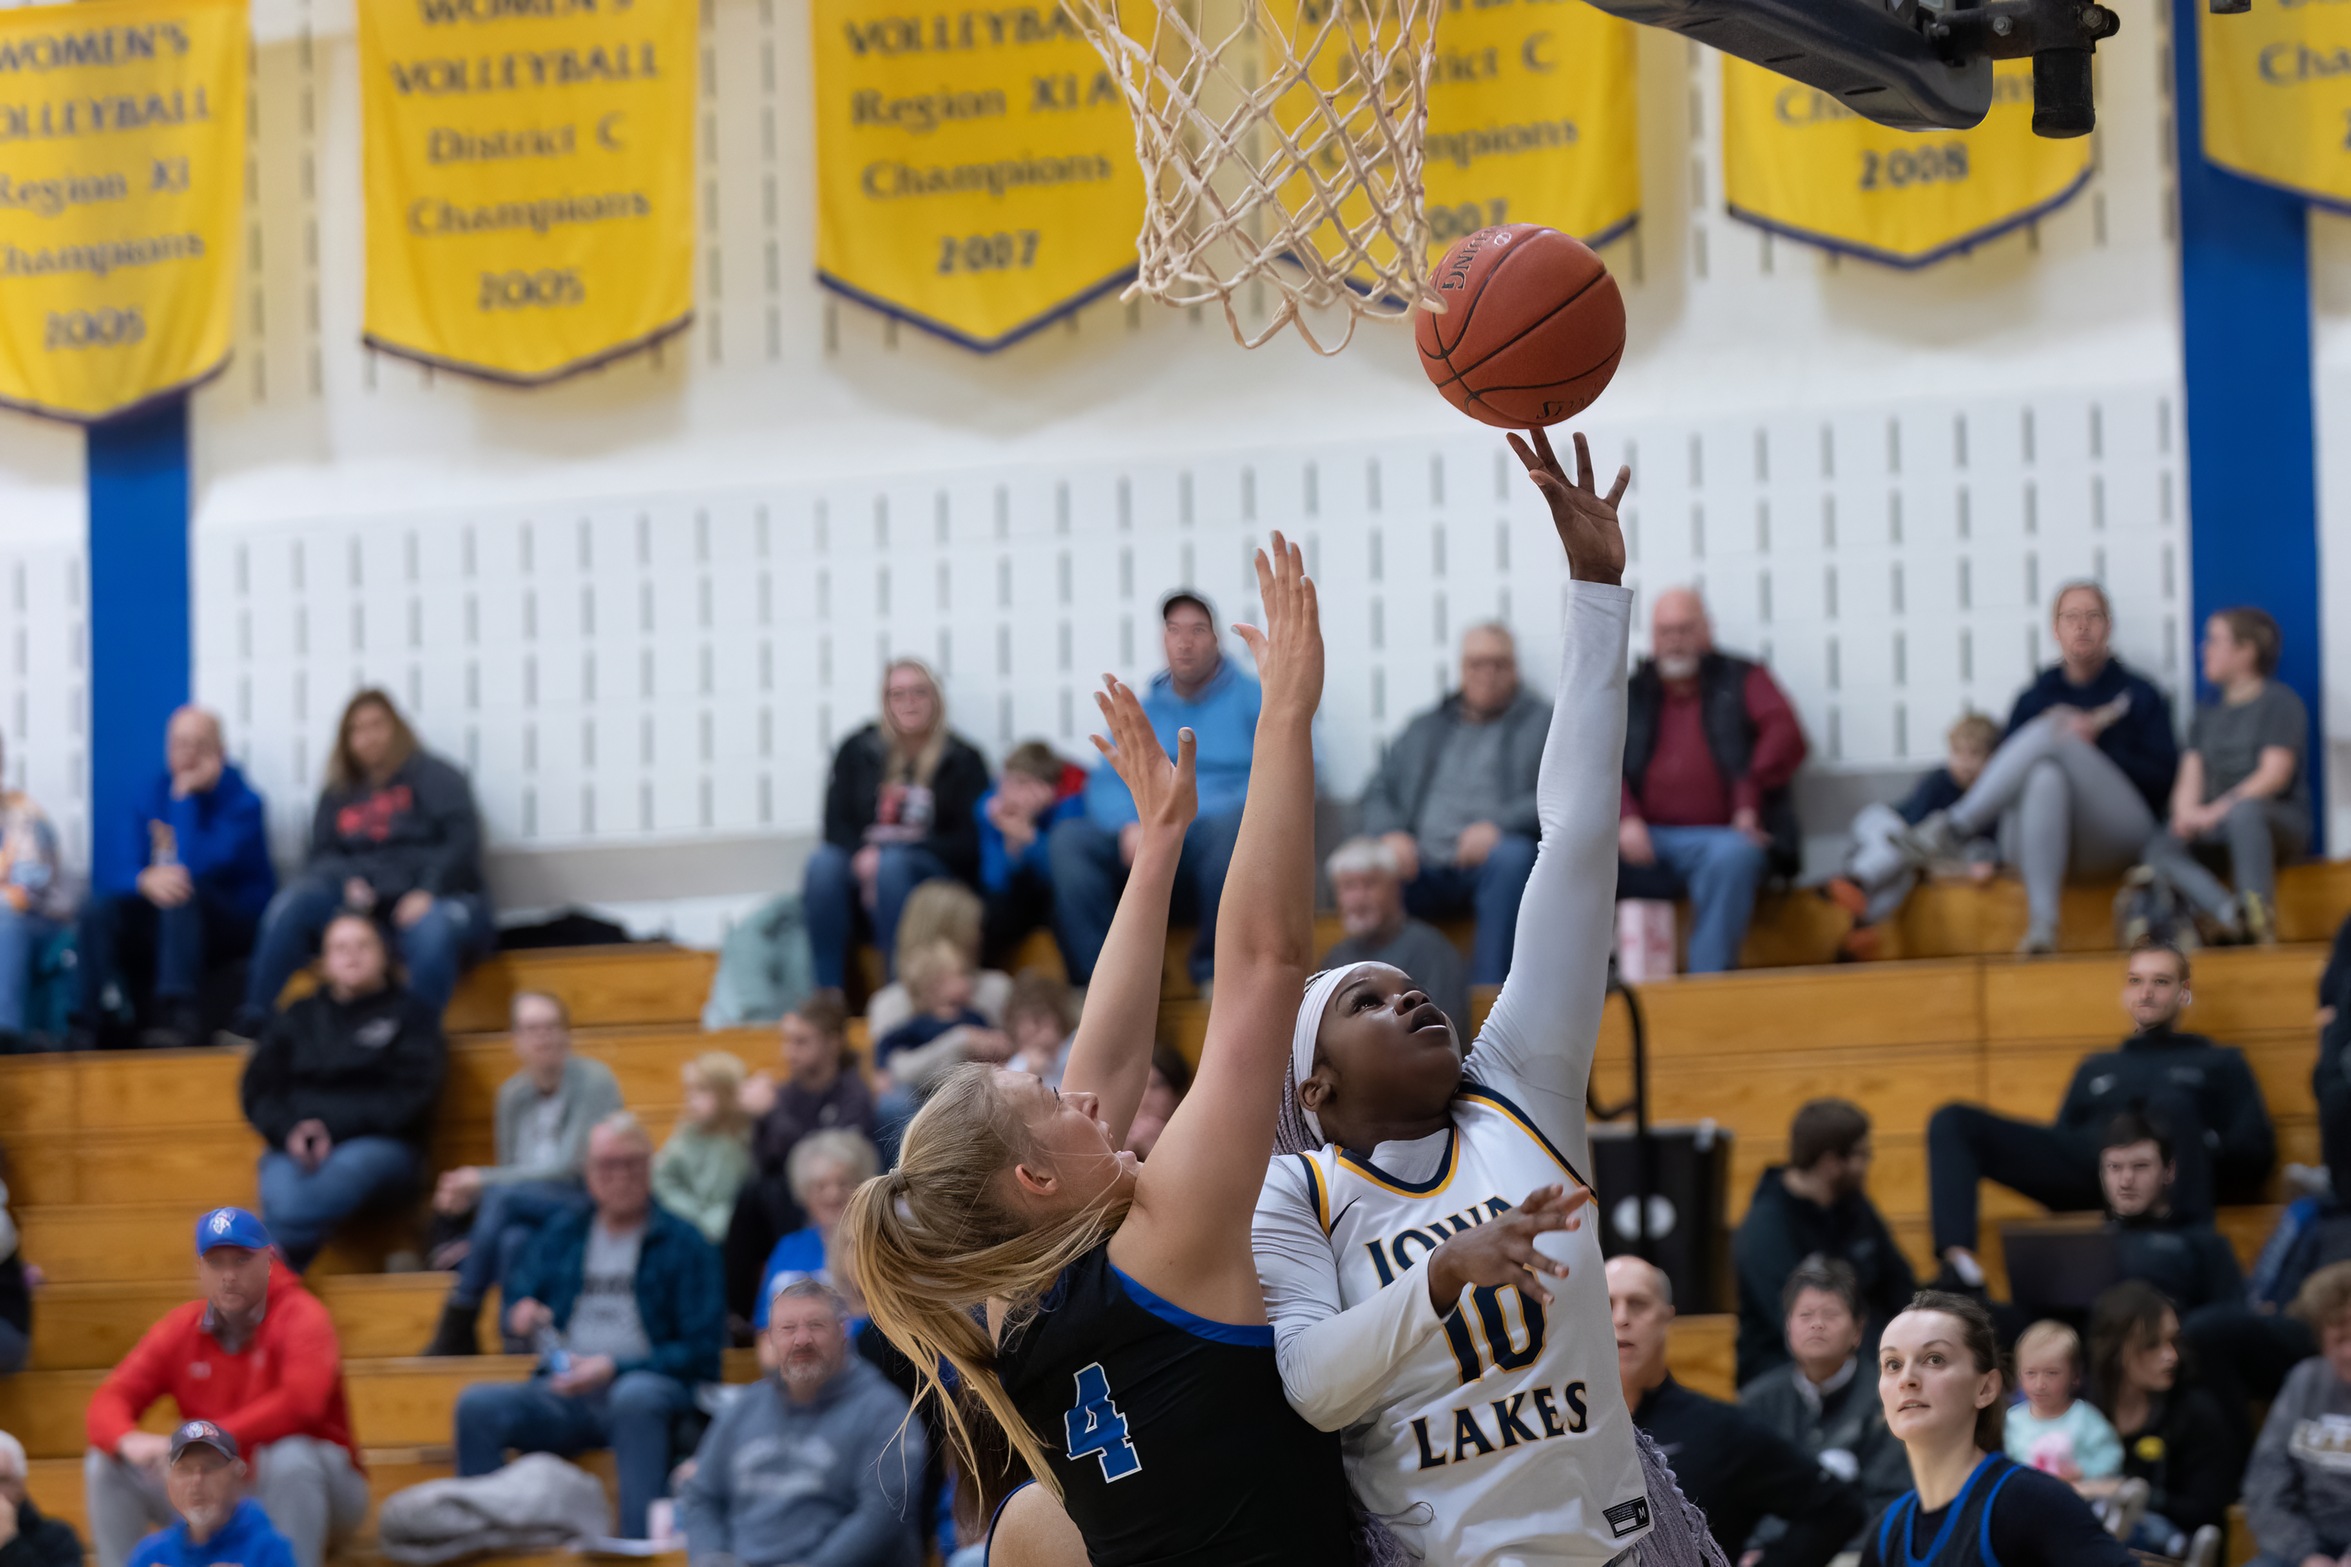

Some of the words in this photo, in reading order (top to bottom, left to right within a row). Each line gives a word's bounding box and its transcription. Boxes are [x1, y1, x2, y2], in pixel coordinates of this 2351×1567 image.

[843, 3, 1105, 55] VOLLEYBA
[1520, 31, 1559, 73] C
[388, 41, 661, 97] VOLLEYBALL
[0, 83, 211, 142] OLLEYBALL
[851, 85, 1006, 137] Region
[427, 124, 578, 166] District
[595, 110, 629, 153] C
[1318, 120, 1579, 173] Cmpions
[861, 152, 1113, 202] Champions
[1858, 141, 1971, 192] 2008
[406, 189, 651, 238] Champions
[0, 232, 207, 280] hampions
[936, 229, 1043, 277] 2007
[476, 264, 586, 313] 2005
[1442, 1263, 1548, 1386] 10
[1064, 1361, 1143, 1484] 4
[1410, 1379, 1589, 1472] LAKES
[1637, 1506, 1647, 1520] M
